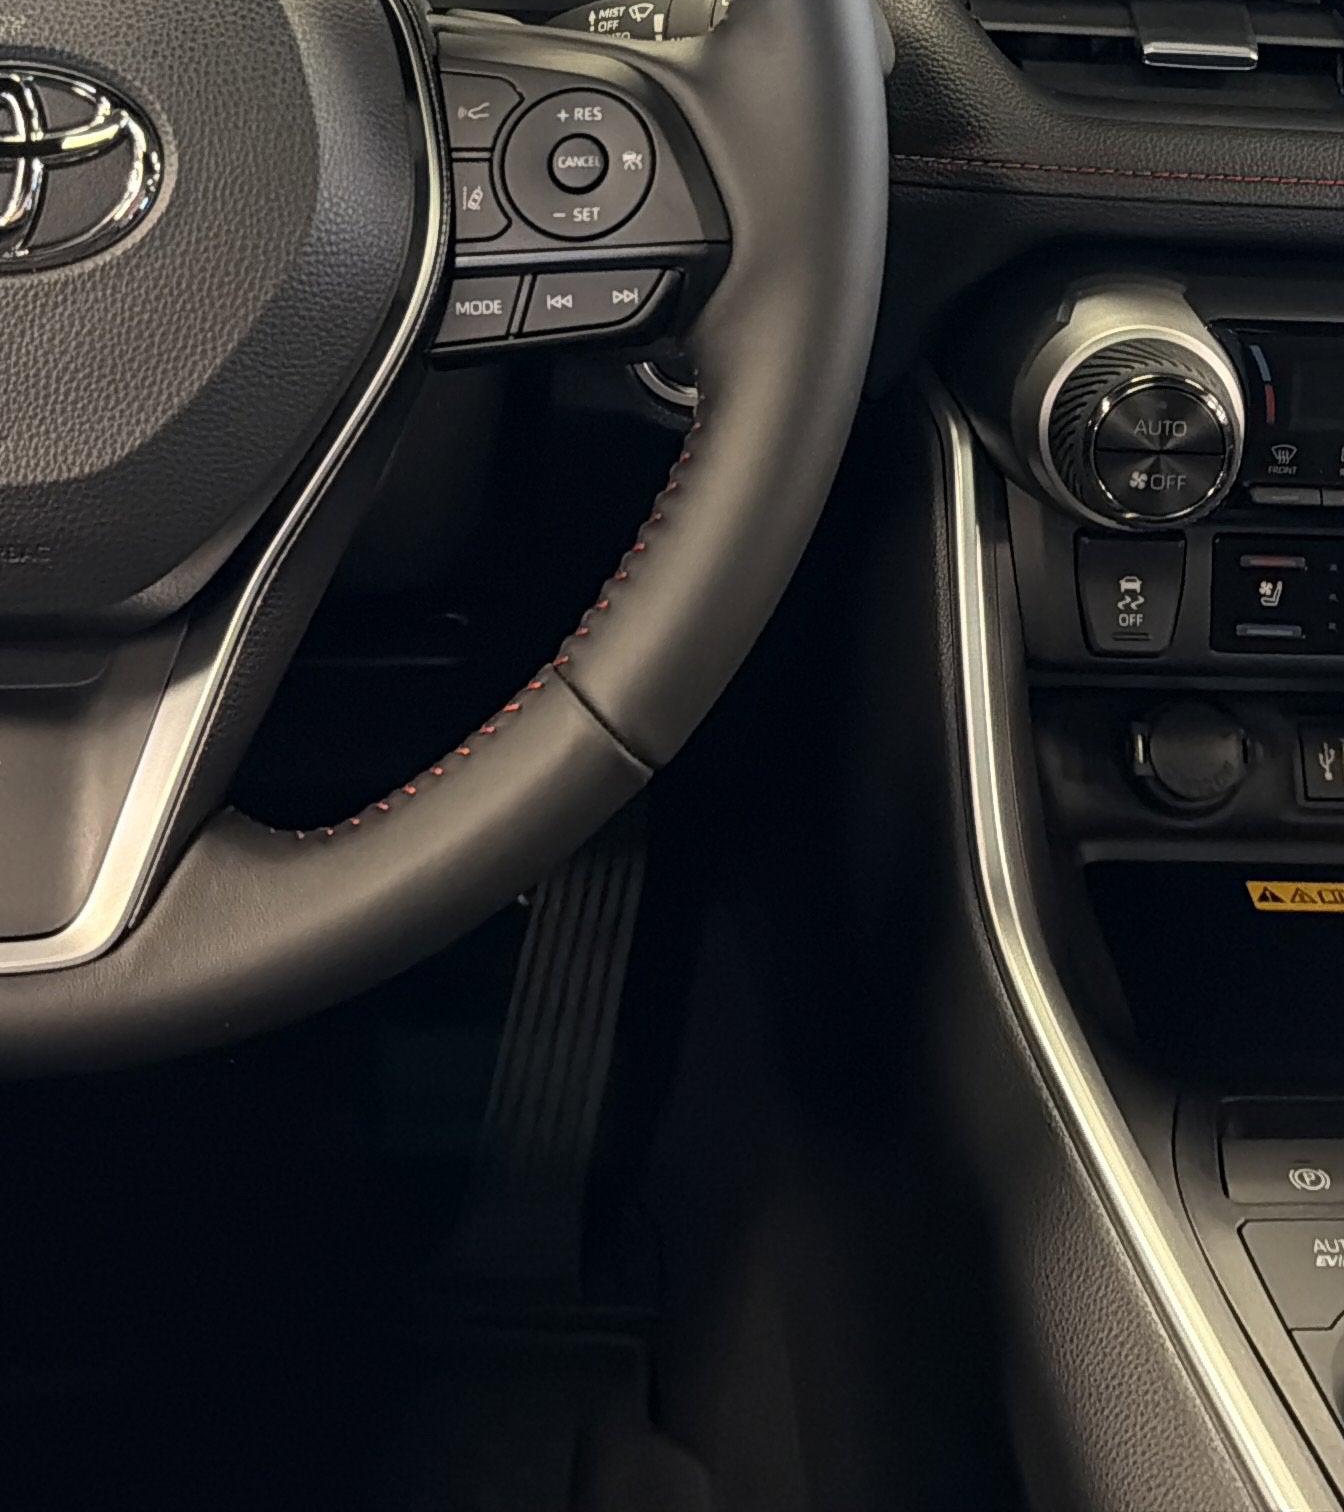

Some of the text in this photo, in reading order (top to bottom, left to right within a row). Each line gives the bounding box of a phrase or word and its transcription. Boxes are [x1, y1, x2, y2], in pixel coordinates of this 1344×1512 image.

[598, 5, 626, 20] MIST
[597, 19, 620, 32] OFF
[573, 106, 603, 121] RES
[557, 155, 601, 168] CANCEL
[572, 207, 601, 221] SET
[456, 300, 503, 316] MODE
[1133, 419, 1188, 437] AUTO
[1267, 465, 1298, 476] FRONT
[1150, 473, 1187, 491] OFF
[1118, 613, 1144, 627] OFF
